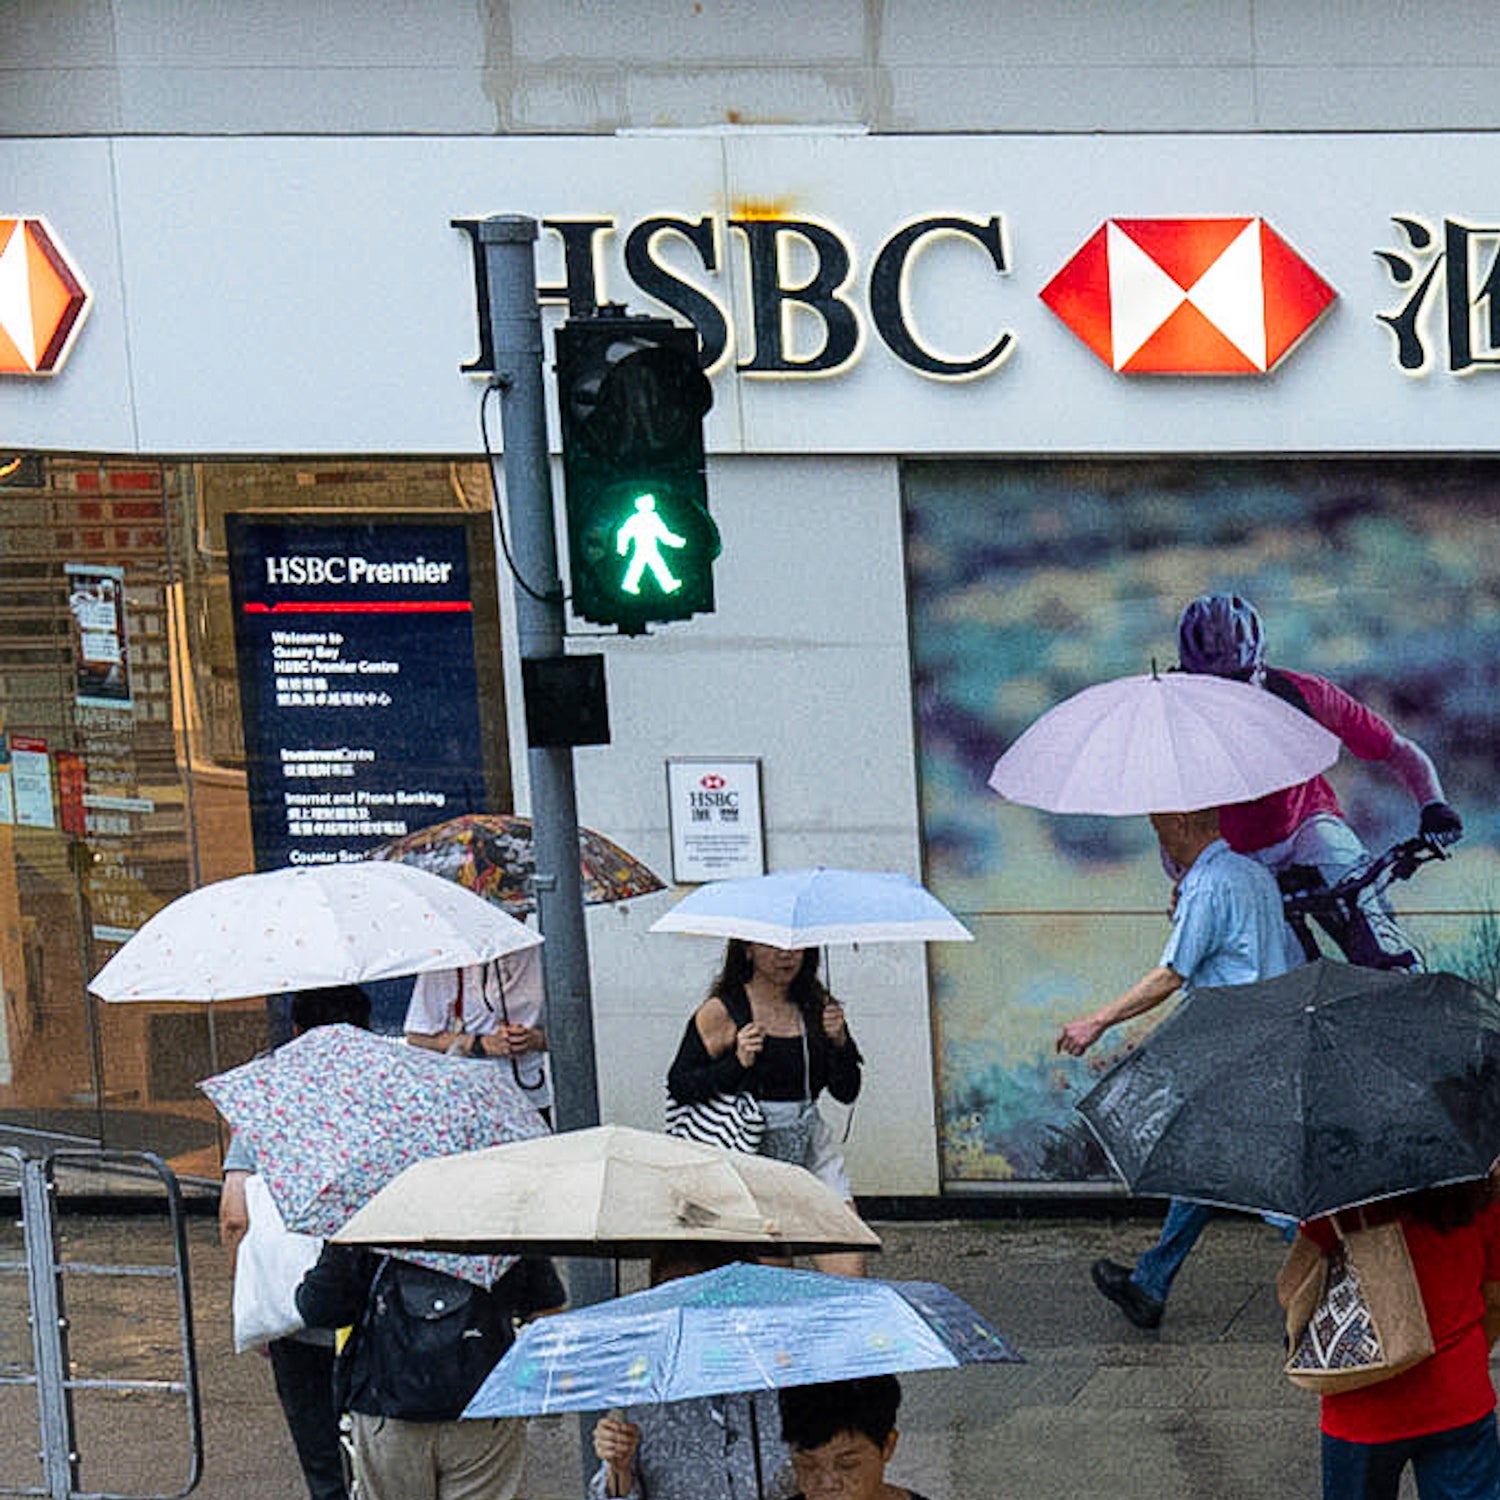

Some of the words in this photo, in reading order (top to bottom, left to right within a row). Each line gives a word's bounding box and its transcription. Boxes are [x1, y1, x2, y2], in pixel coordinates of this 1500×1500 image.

[450, 215, 1015, 380] HSBC
[266, 557, 346, 584] HSBC
[350, 556, 452, 584] Premier
[271, 632, 327, 645] Welcome
[284, 792, 332, 805] Internet
[333, 792, 355, 805] and
[357, 792, 395, 805] Phone
[396, 791, 446, 806] Banking
[689, 791, 739, 807] HSBC
